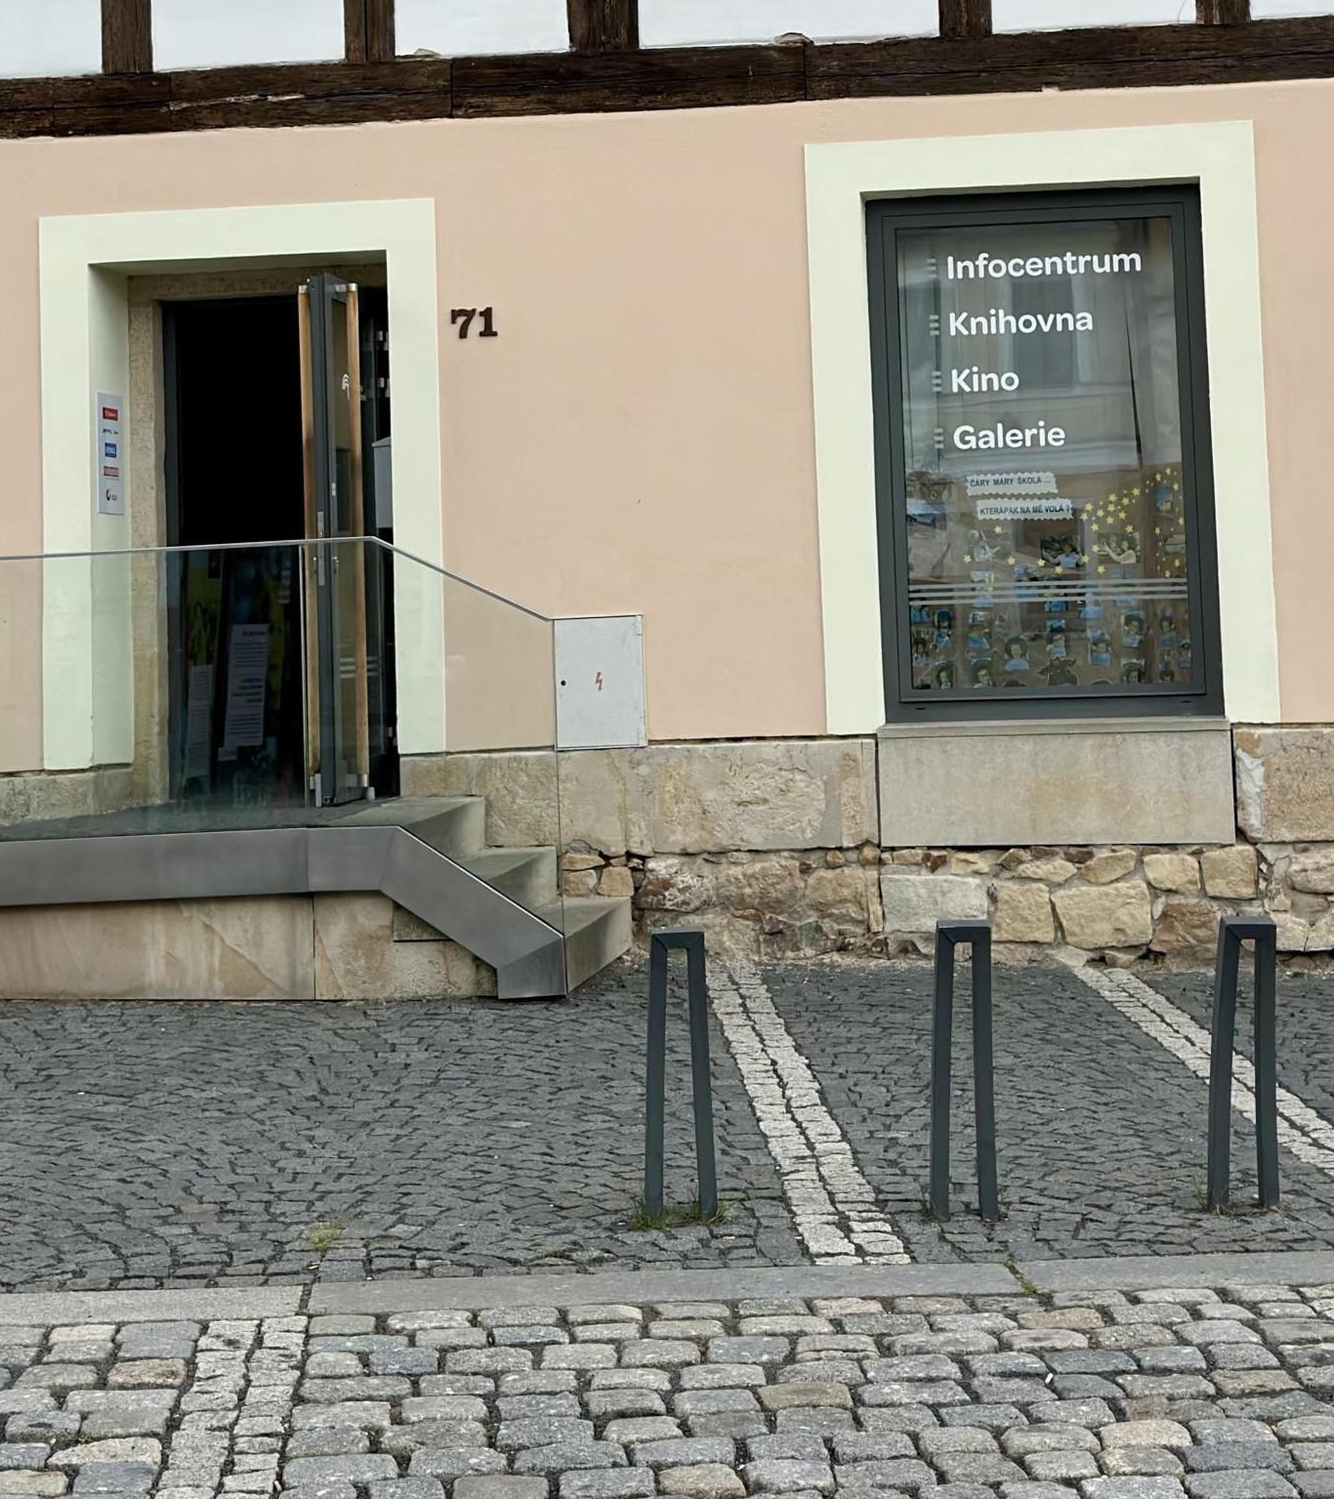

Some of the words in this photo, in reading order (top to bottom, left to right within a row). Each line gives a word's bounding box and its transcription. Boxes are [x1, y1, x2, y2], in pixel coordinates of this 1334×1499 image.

[947, 251, 1142, 280] Infocentrum
[450, 306, 498, 339] 71
[949, 308, 1094, 336] Knihovna
[951, 366, 1020, 393] Kino
[953, 420, 1066, 449] Galerie
